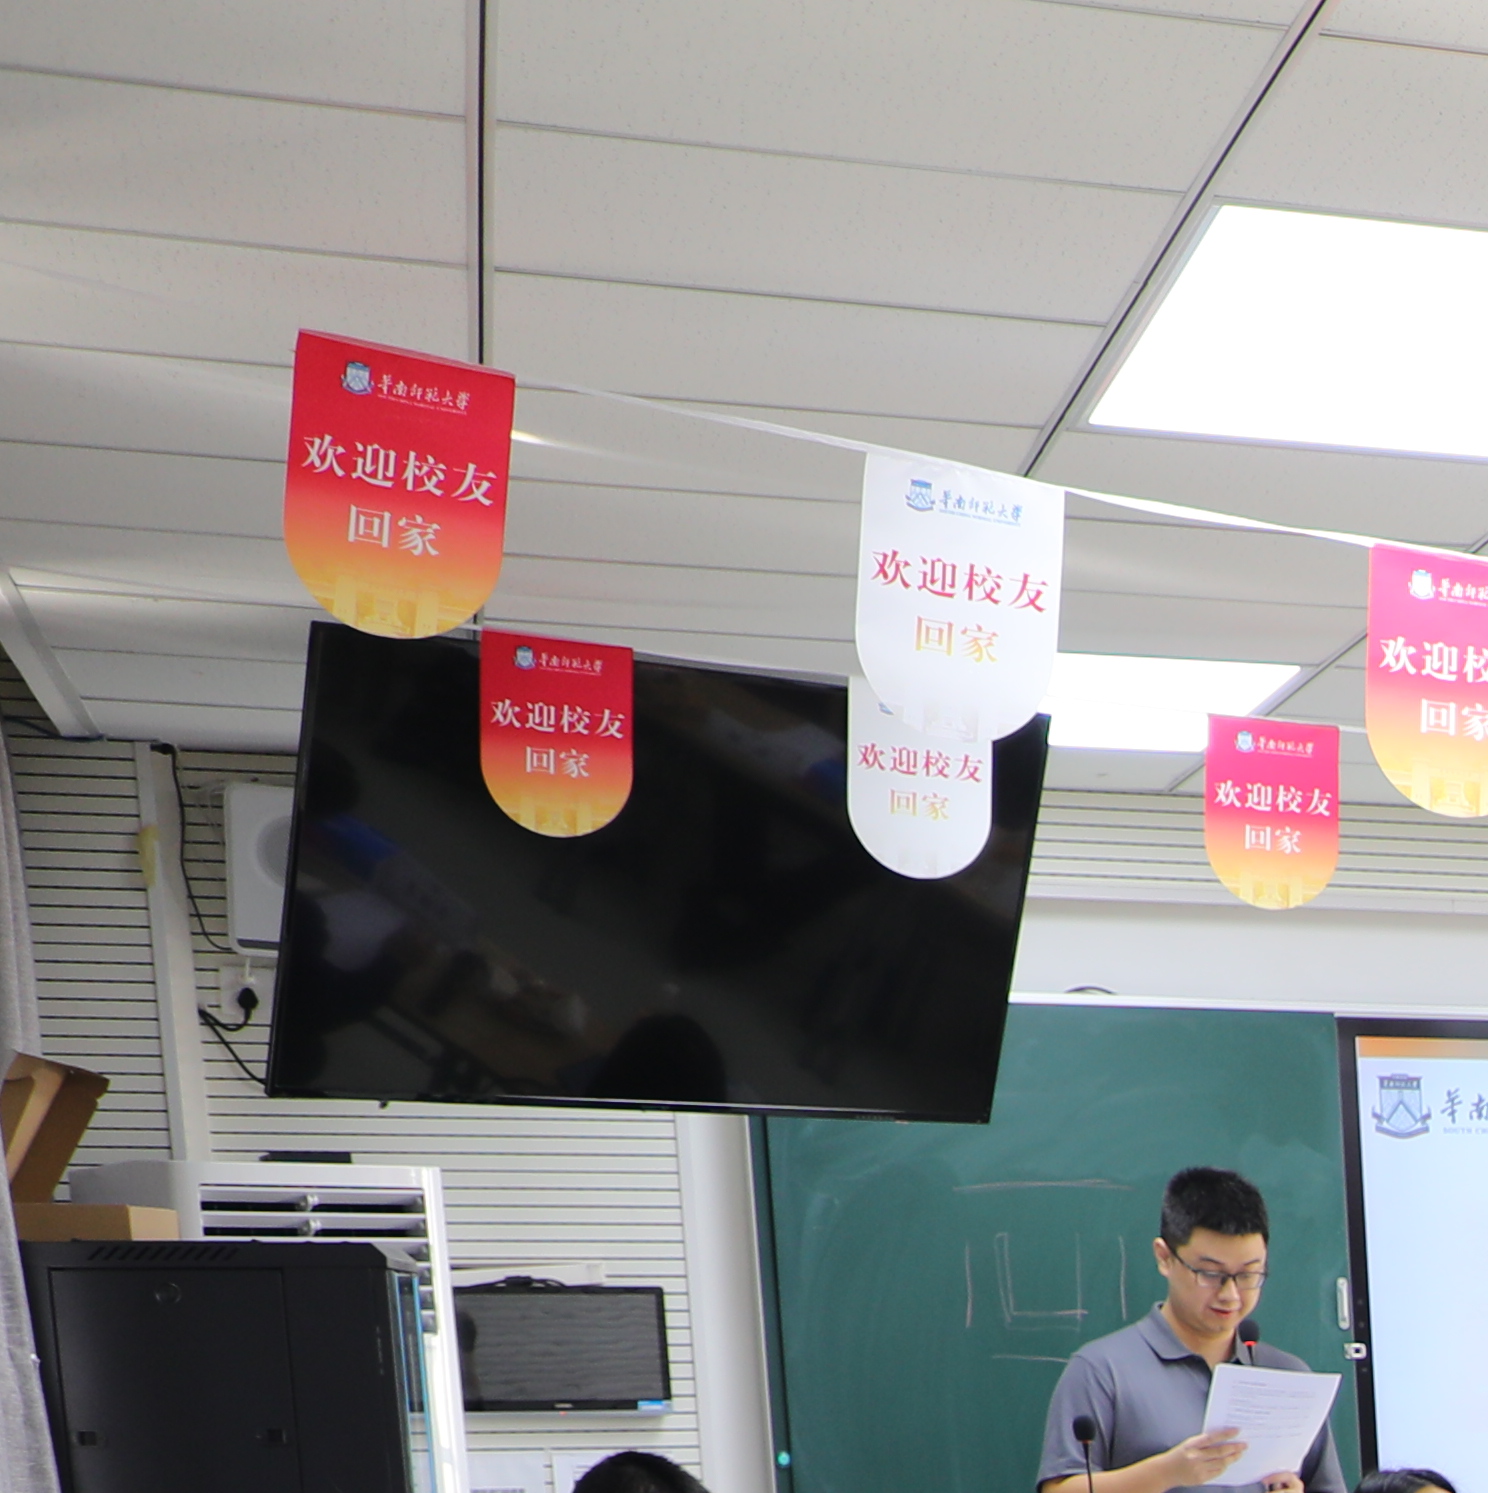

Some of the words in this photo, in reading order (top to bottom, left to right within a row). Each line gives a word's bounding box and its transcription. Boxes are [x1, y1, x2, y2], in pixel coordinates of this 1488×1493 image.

[302, 434, 497, 506] 欢迎校友
[348, 504, 441, 556] 回家
[870, 549, 1048, 614] 欢迎校友
[915, 615, 1000, 663] 回家
[491, 699, 626, 739] 欢迎校友
[525, 746, 590, 778] 回家
[857, 742, 983, 783] 欢迎校友
[889, 788, 950, 821] 回家
[1214, 780, 1332, 817] 欢迎校友
[1244, 824, 1302, 854] 回家
[1443, 1127, 1473, 1135] SOUTH
